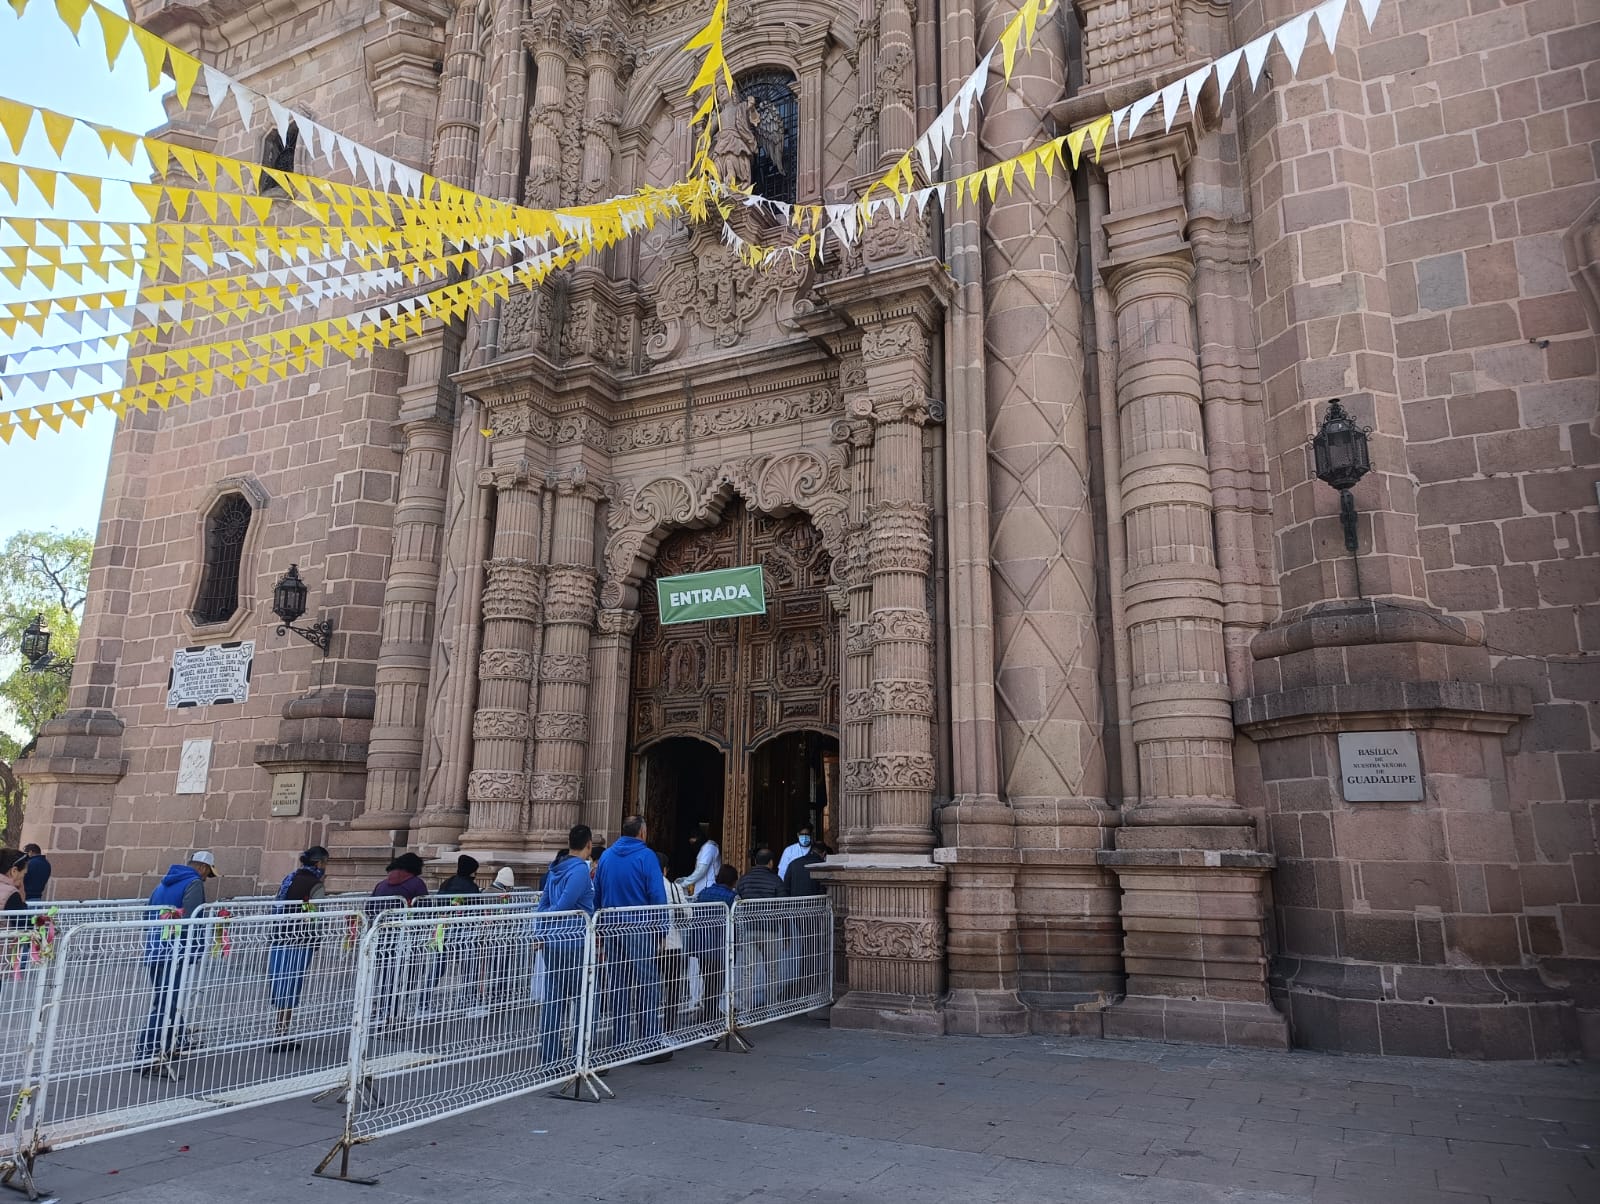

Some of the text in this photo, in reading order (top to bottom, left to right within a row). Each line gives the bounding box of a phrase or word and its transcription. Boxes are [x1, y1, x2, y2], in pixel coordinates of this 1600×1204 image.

[669, 584, 751, 607] ENTRADA
[1358, 747, 1398, 756] BASÍLICA
[1347, 776, 1416, 784] GUADALUPE
